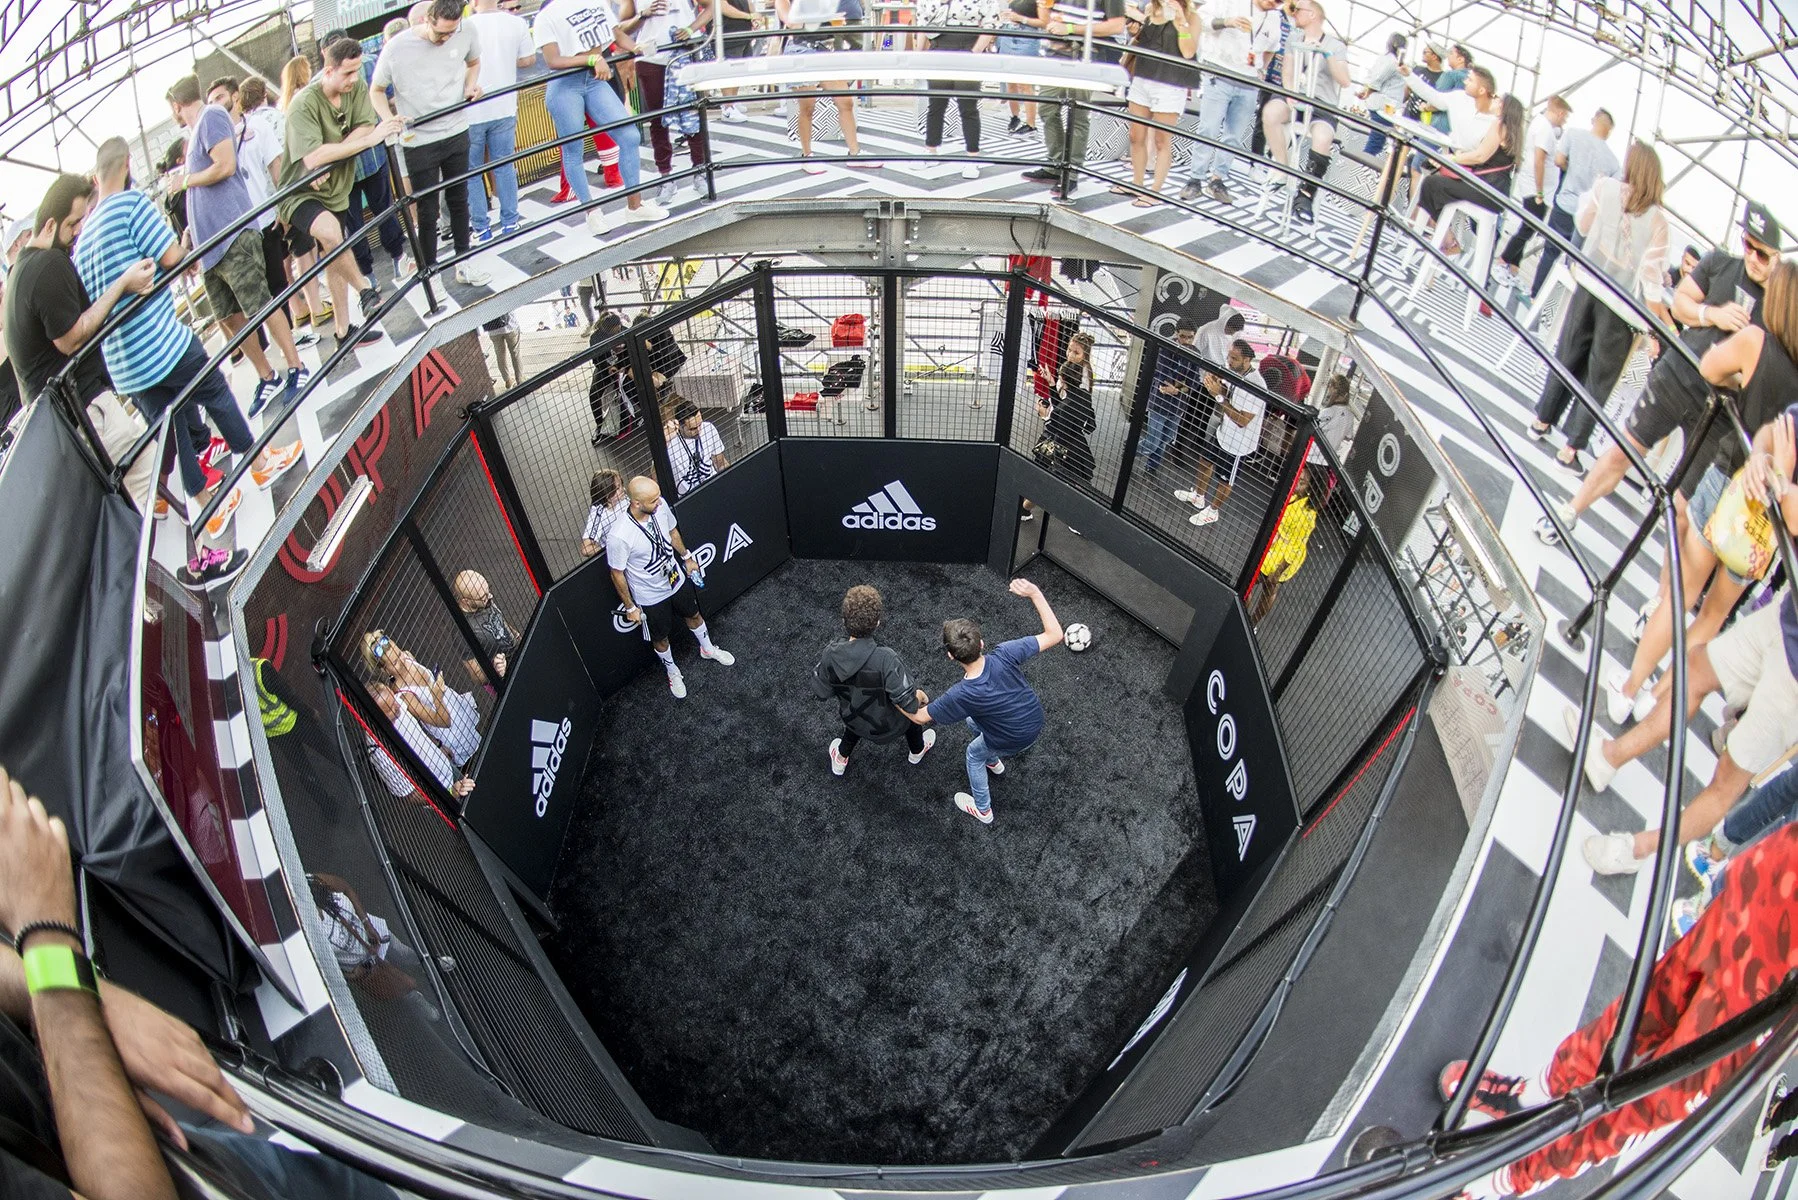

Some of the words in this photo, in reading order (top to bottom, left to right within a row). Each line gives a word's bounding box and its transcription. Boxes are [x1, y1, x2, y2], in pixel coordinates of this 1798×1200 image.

[841, 511, 937, 531] adidas
[612, 522, 754, 634] CPA
[535, 716, 572, 818] adidas
[1206, 668, 1257, 863] COPA
